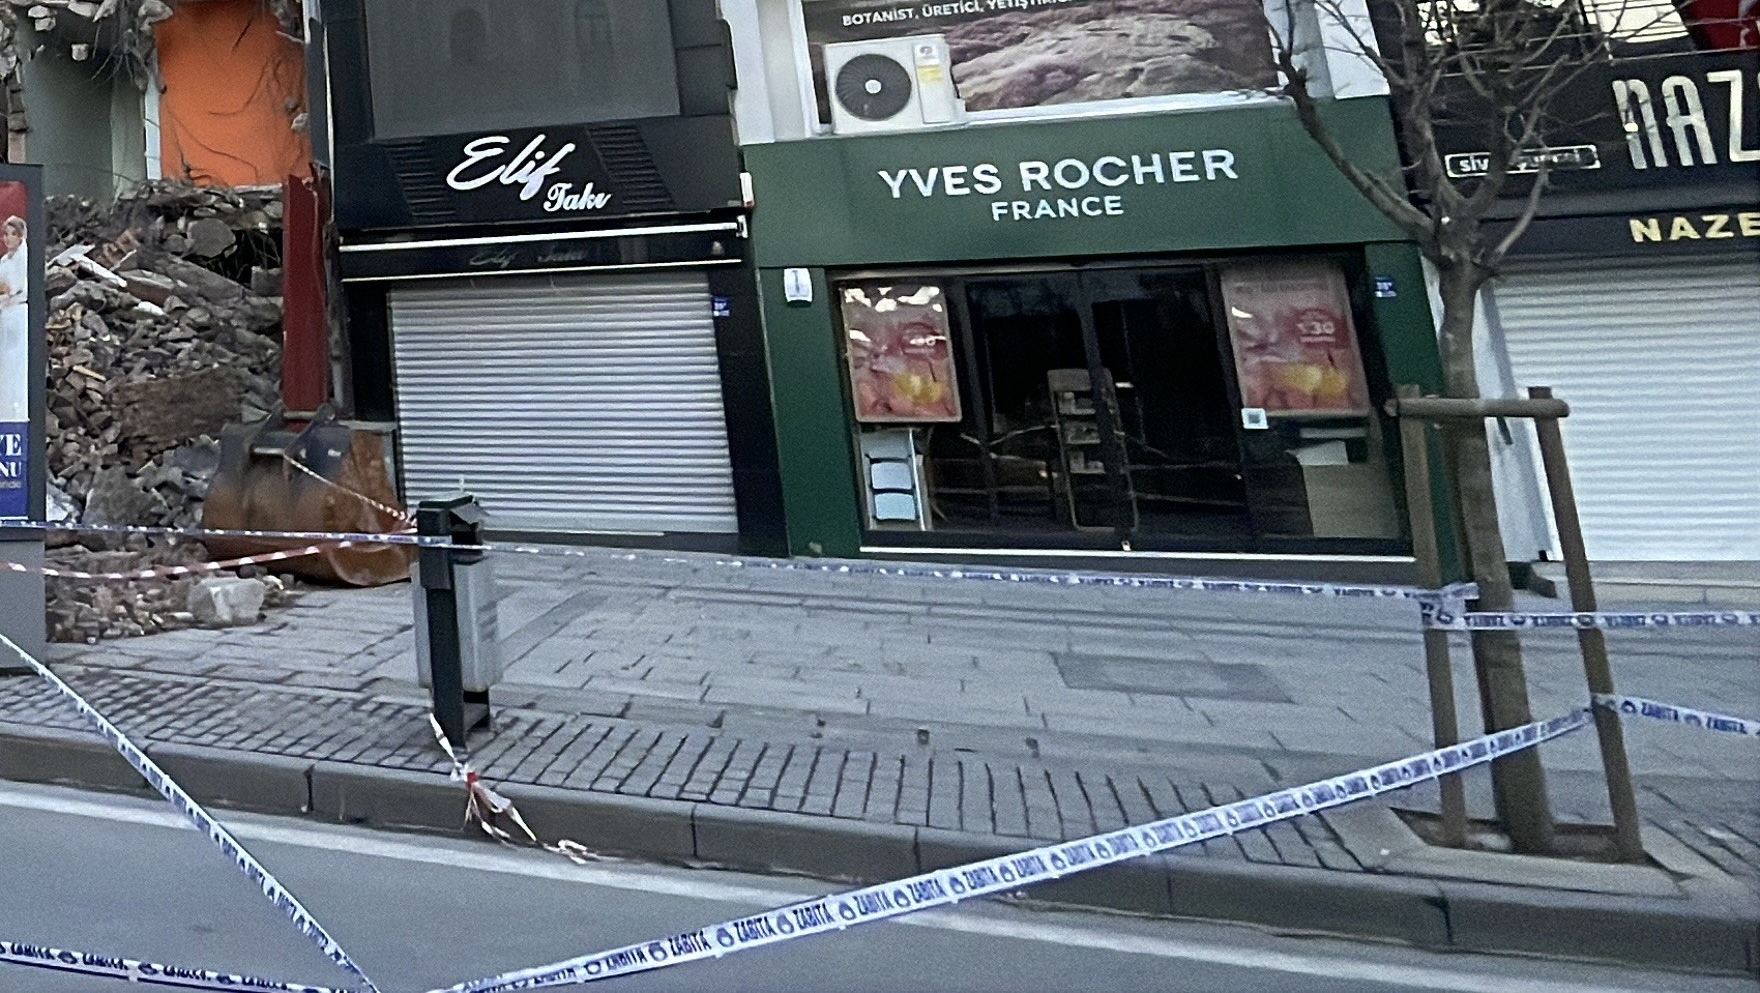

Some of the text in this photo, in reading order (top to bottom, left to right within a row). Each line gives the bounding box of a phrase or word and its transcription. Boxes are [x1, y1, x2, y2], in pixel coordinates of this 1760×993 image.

[1612, 68, 1760, 169] NAZ
[446, 134, 576, 201] Elif
[878, 149, 1238, 198] YVES ROCHER
[991, 195, 1124, 221] FRANCE
[668, 931, 712, 956] ZABITA
[735, 916, 776, 942] ZABITA
[793, 903, 834, 930] ZABITA
[853, 890, 894, 916] ZABITA
[906, 878, 948, 904] ZABITA
